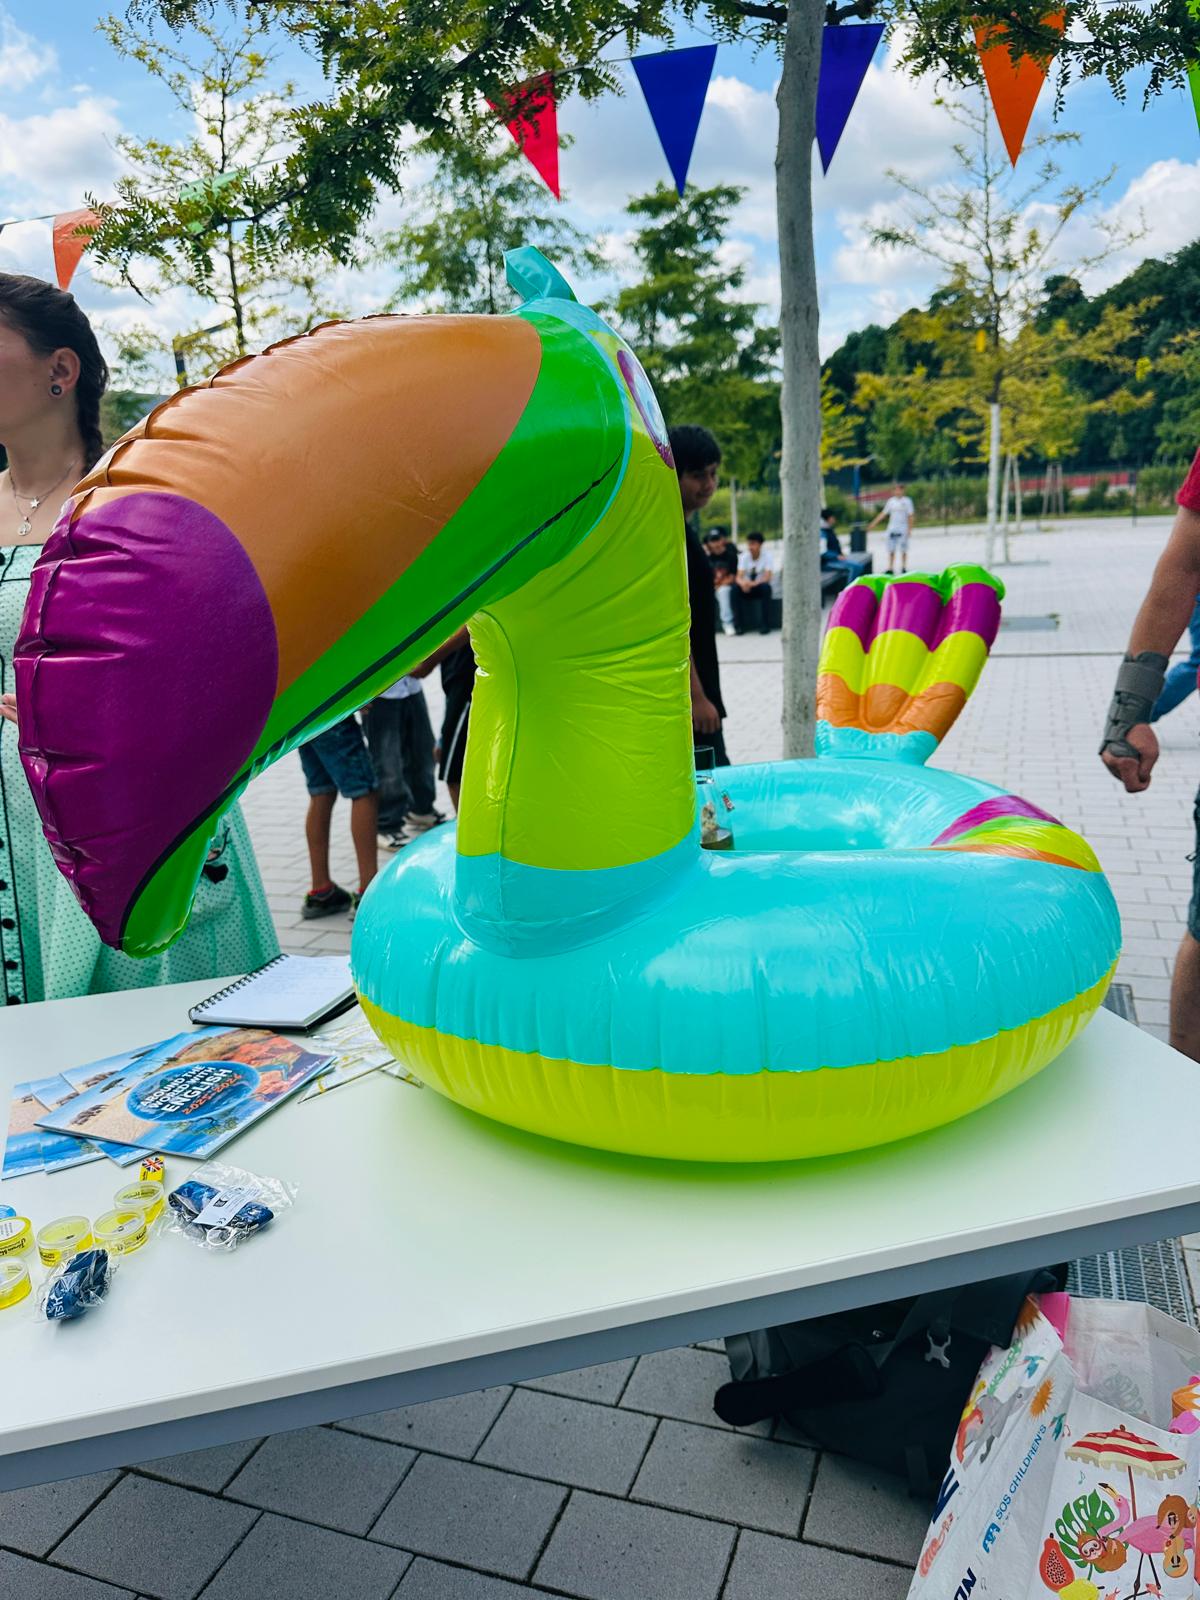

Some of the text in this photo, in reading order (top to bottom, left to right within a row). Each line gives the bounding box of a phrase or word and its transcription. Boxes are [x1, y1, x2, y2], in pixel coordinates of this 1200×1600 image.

[140, 1064, 206, 1107] AROUND THE
[149, 1066, 217, 1109] WORLD WITH
[161, 1068, 233, 1113] ENGLISH
[995, 1424, 1047, 1520] SOS CHILDREN'S
